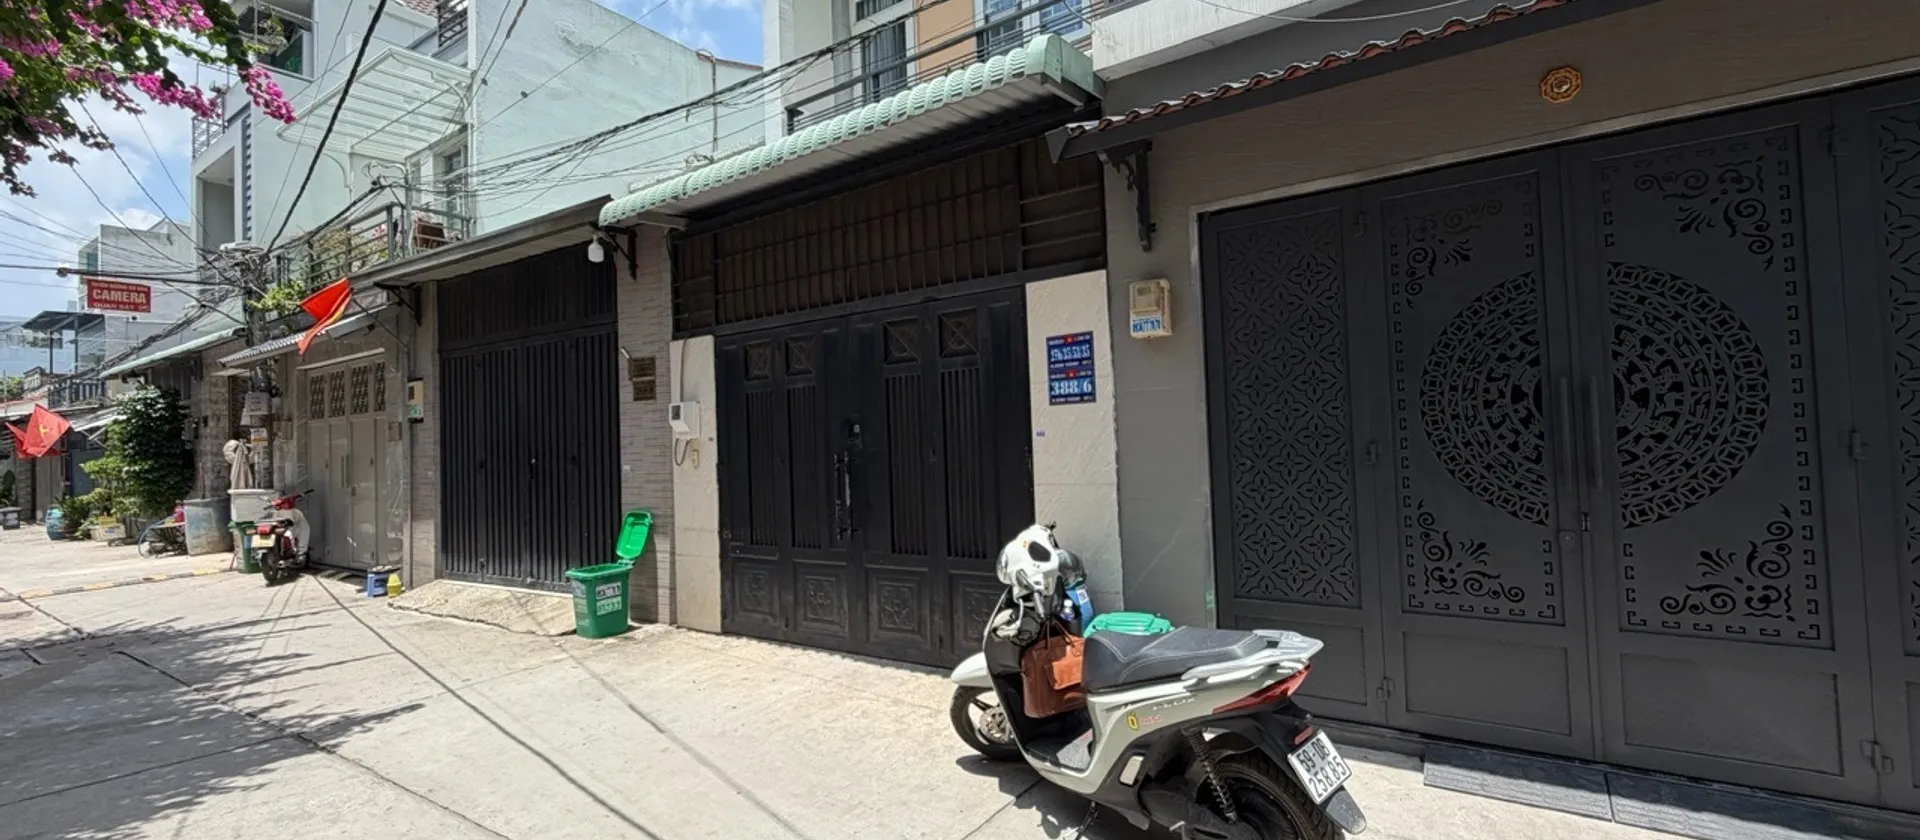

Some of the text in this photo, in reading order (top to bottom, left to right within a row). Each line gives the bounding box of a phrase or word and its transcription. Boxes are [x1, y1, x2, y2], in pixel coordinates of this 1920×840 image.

[92, 288, 147, 304] CAMERA
[1051, 378, 1092, 396] 388/6
[1308, 755, 1347, 798] 258.85
